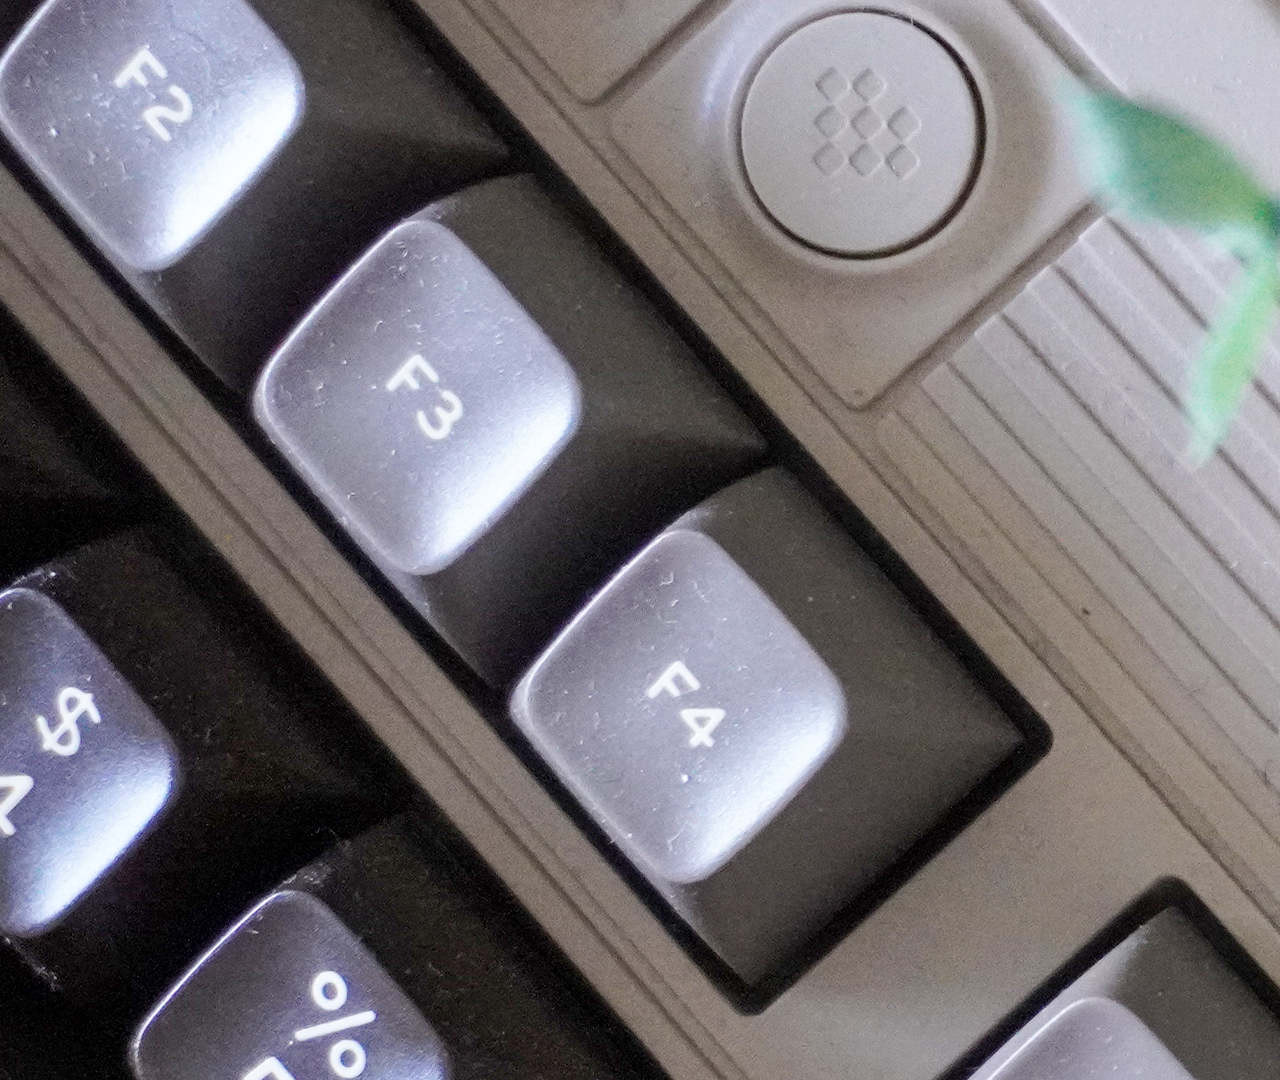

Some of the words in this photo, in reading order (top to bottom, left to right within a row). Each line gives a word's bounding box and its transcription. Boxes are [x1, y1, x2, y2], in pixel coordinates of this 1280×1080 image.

[114, 45, 194, 141] F2
[385, 354, 464, 441] F3
[36, 687, 100, 756] $
[648, 660, 725, 748] F4
[294, 970, 377, 1080] %
